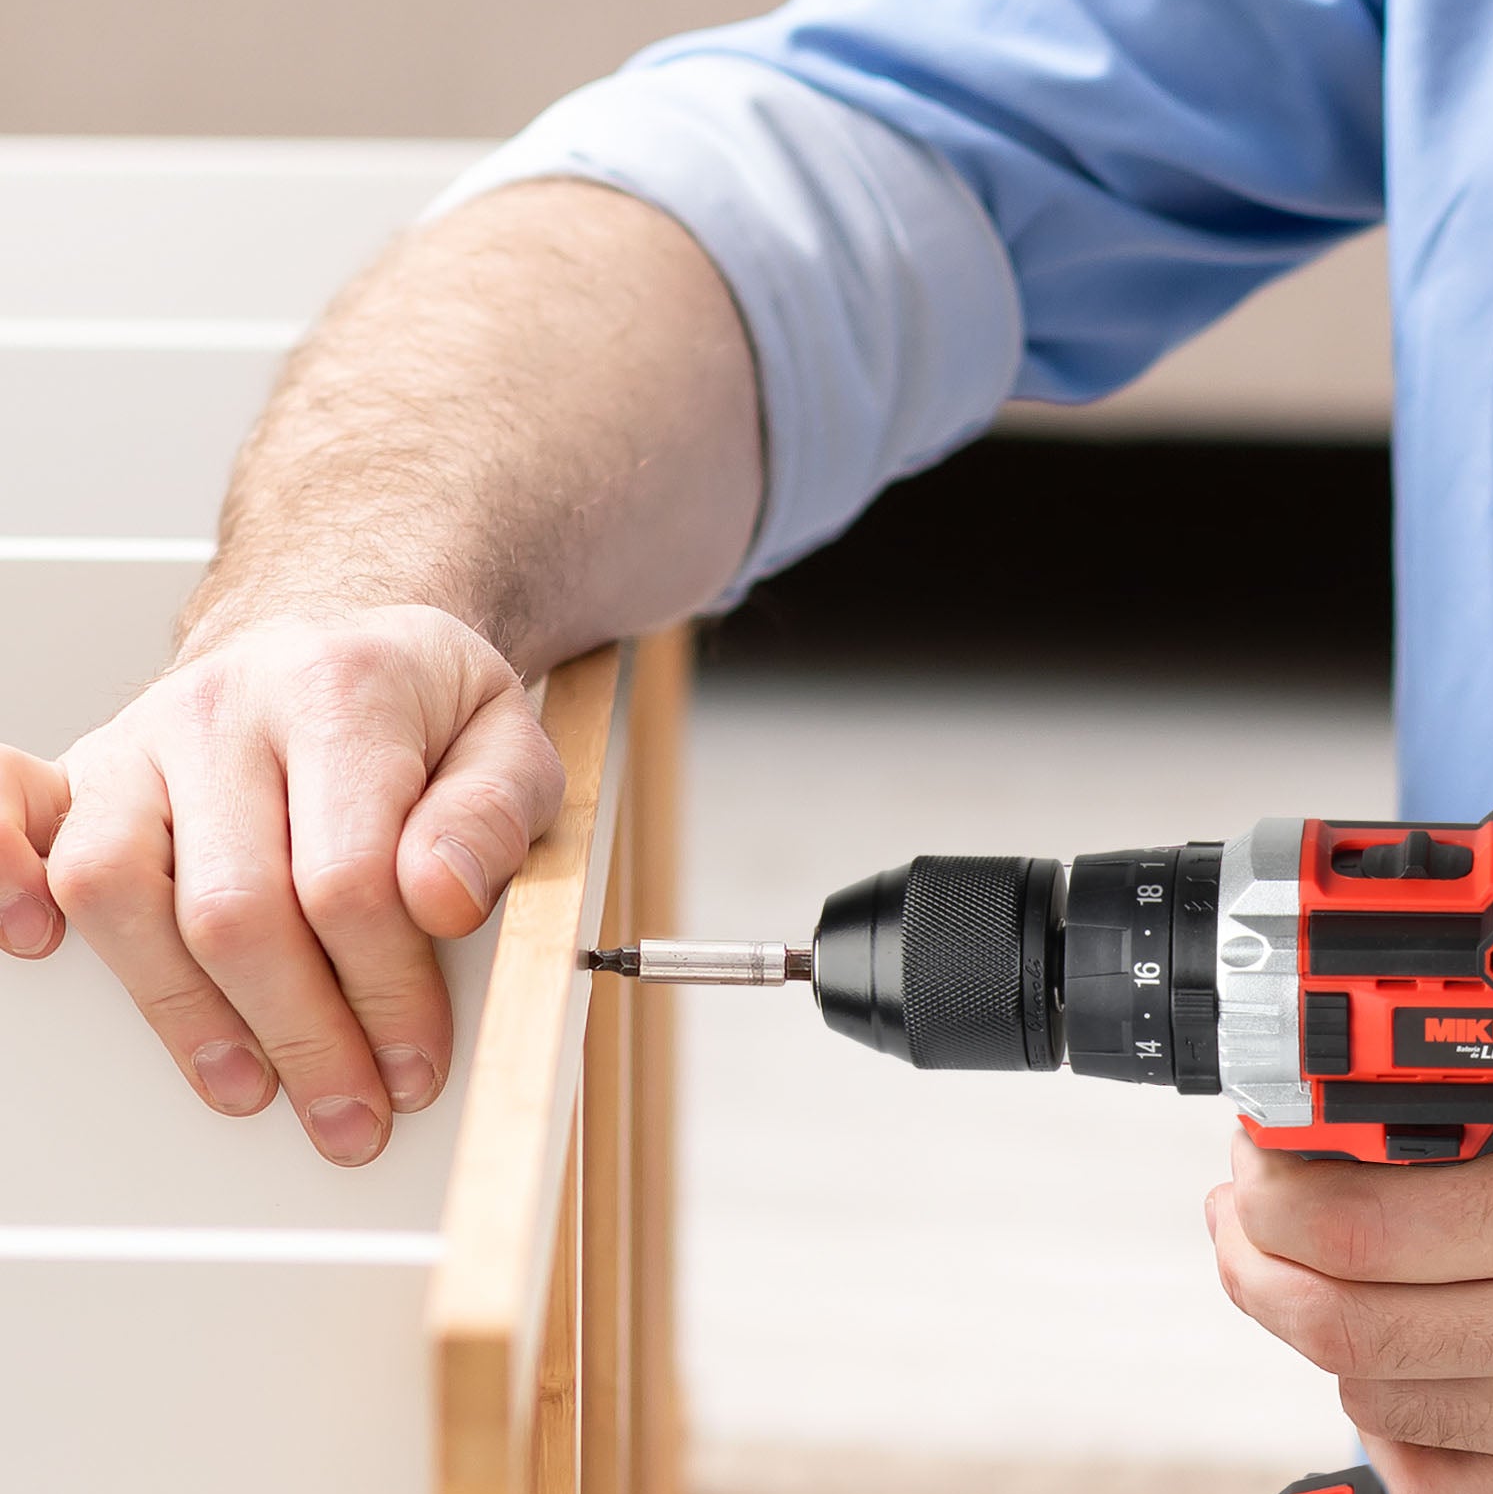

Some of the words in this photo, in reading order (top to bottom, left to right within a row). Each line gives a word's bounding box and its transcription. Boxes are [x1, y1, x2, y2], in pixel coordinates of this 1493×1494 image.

[1137, 884, 1163, 906] 18
[1133, 962, 1161, 988] 16
[1135, 1040, 1162, 1059] 14
